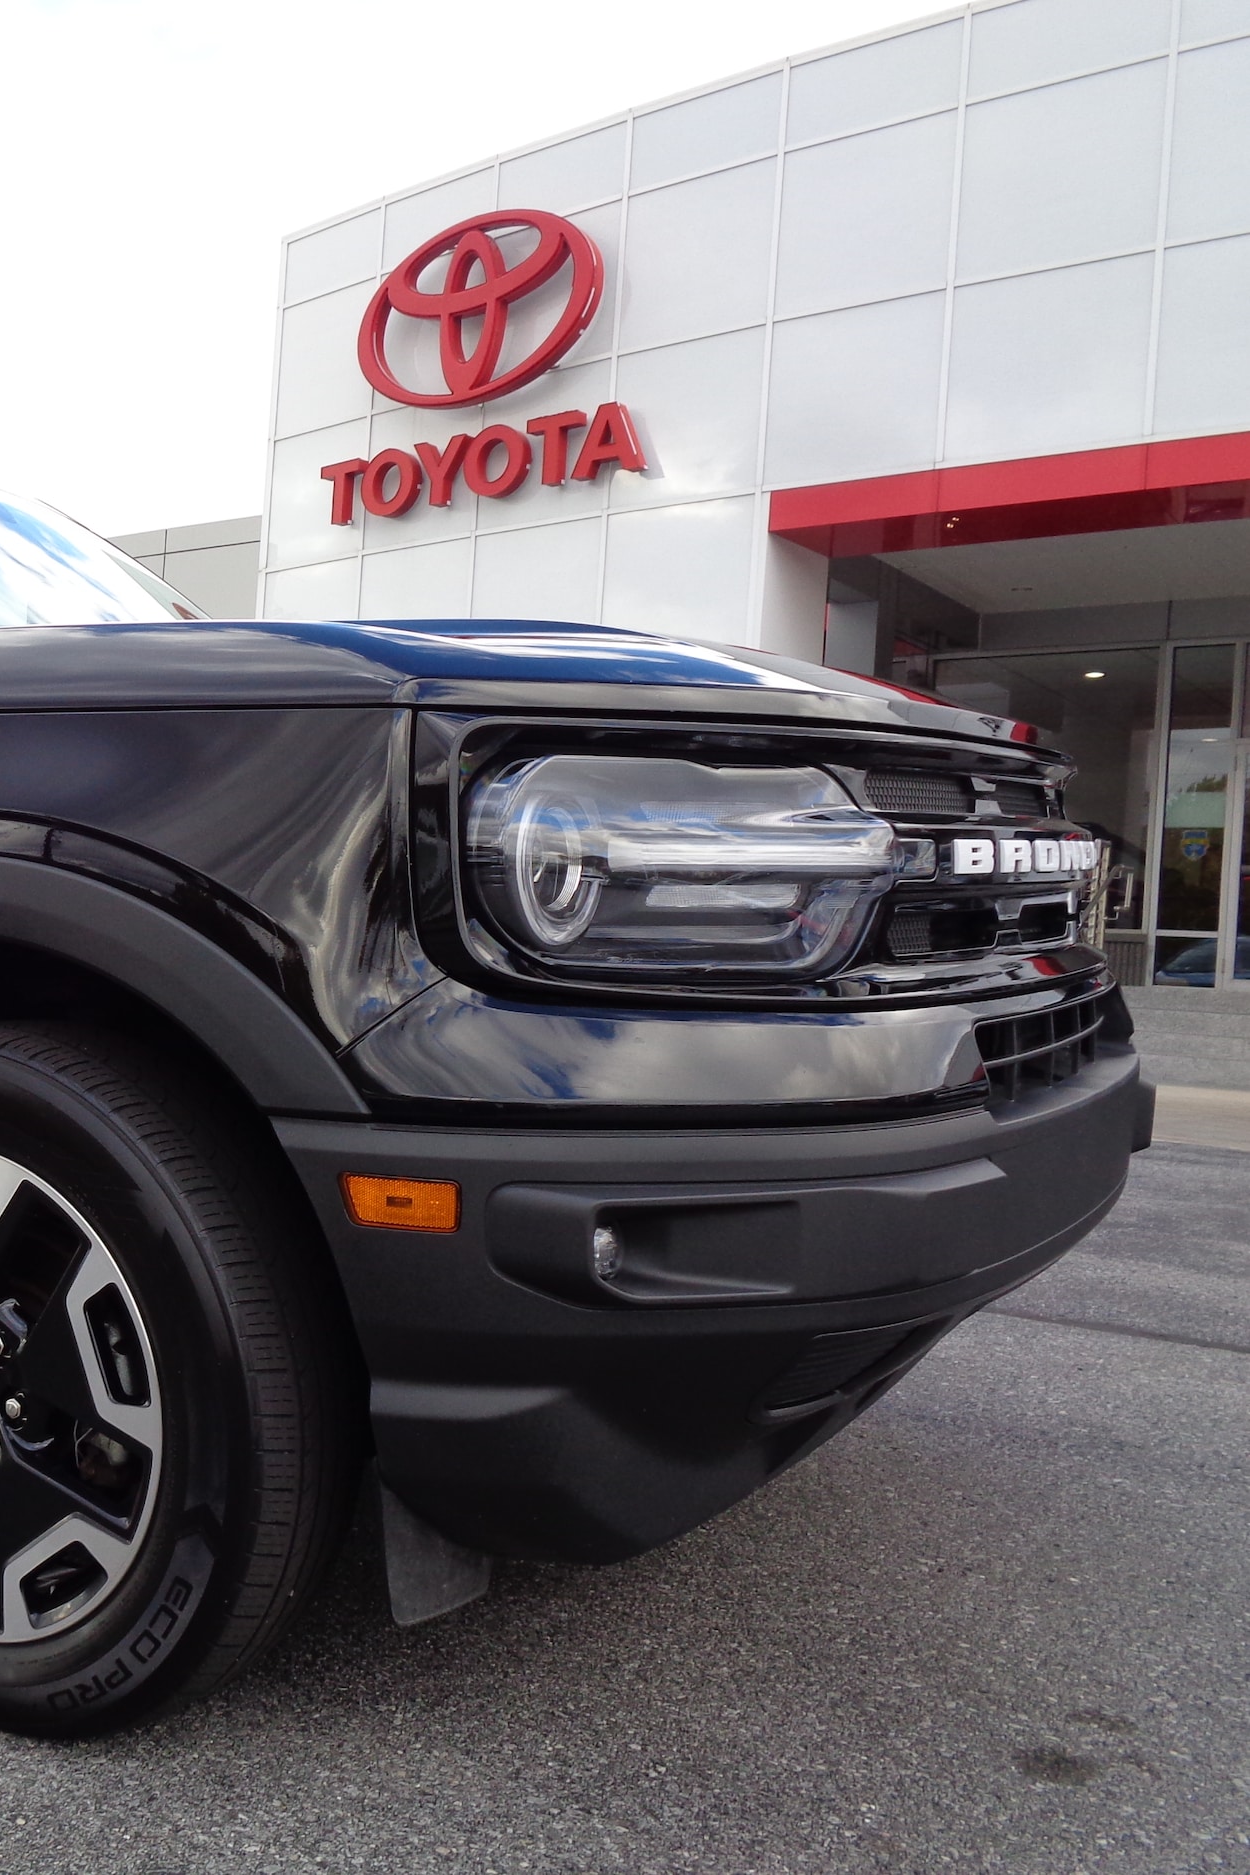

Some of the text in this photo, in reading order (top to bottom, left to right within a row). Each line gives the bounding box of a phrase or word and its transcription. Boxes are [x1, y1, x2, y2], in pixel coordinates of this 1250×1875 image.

[320, 401, 648, 526] TOYOTA
[952, 838, 1097, 874] BRONC
[47, 1576, 193, 1712] ECO PRO
